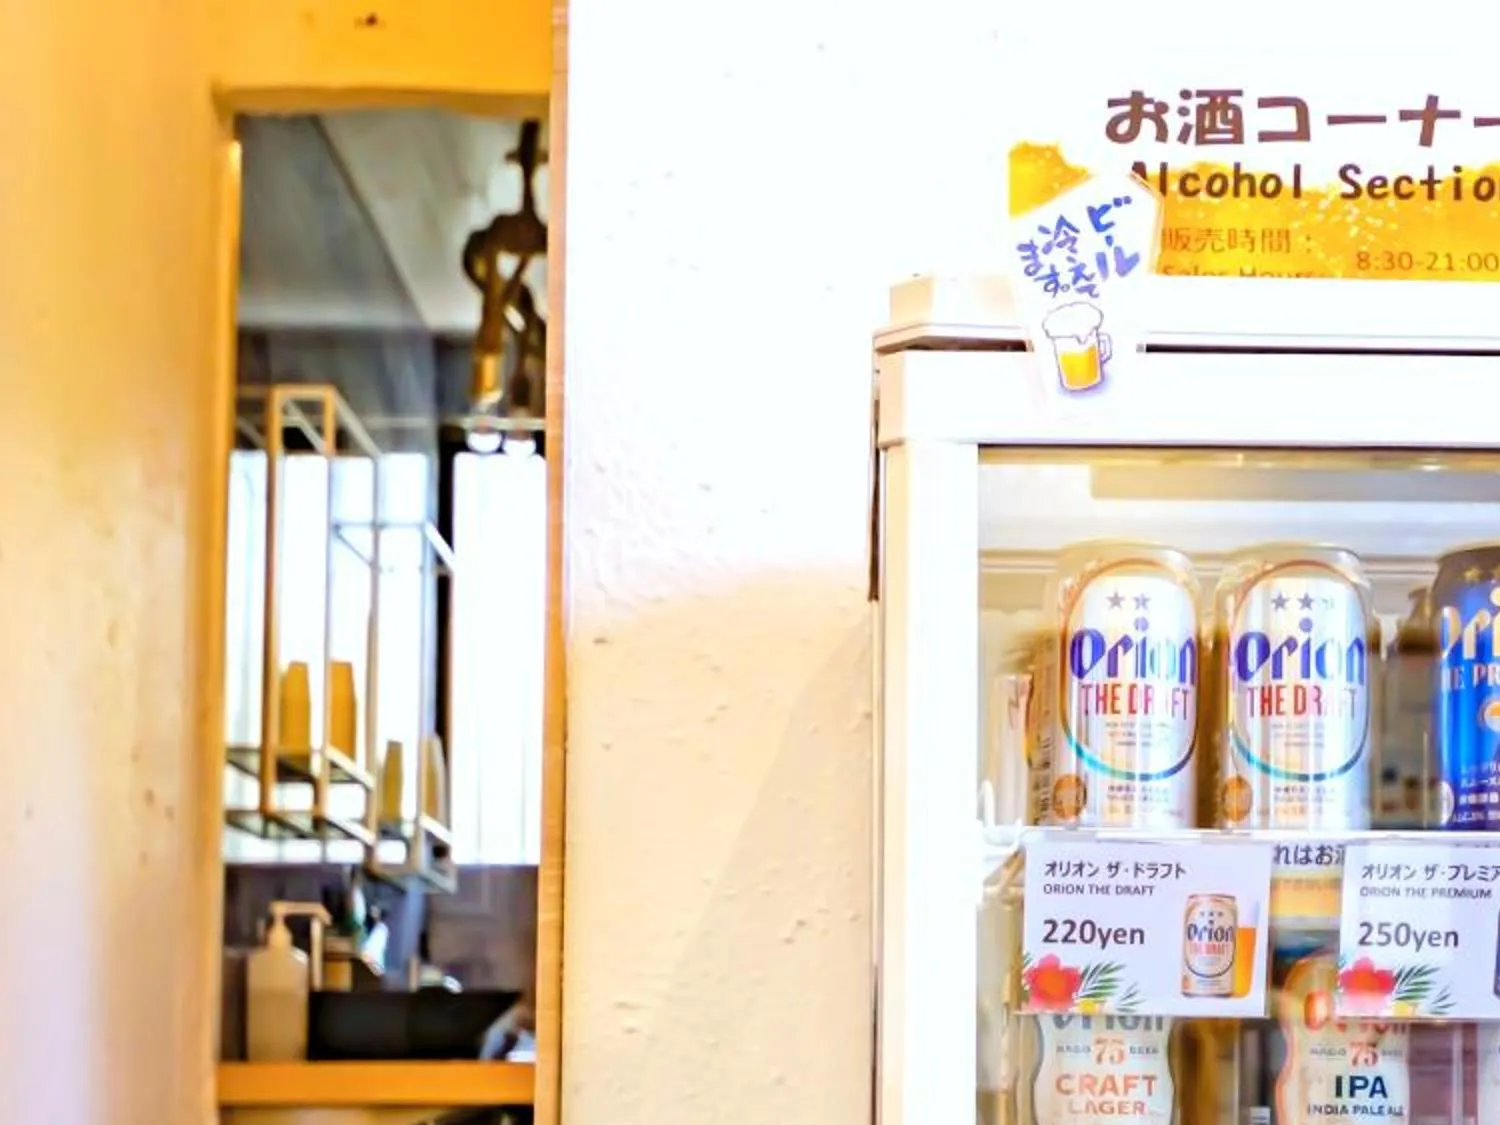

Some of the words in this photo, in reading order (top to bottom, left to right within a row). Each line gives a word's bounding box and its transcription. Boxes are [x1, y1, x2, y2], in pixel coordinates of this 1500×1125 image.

[1355, 251, 1500, 273] 8:30-21:00
[1081, 683, 1122, 716] THE
[1247, 684, 1286, 718] THE
[1044, 861, 1099, 878] オリオン
[1106, 861, 1187, 880] ザ・ドラフト
[1361, 864, 1417, 881] オリオン
[1042, 883, 1086, 896] ORION
[1088, 884, 1111, 896] THE
[1115, 884, 1156, 897] DRAFT
[1359, 887, 1401, 898] ORION
[1404, 887, 1430, 899] THE
[1431, 888, 1493, 900] PREMIUM
[1042, 918, 1146, 950] 220yen
[1357, 921, 1460, 952] 250yen
[1056, 1073, 1159, 1097] CRAFT
[1335, 1075, 1389, 1099] IPA
[1068, 1099, 1148, 1116] LAGER
[1307, 1103, 1350, 1116] INDIA
[1352, 1103, 1386, 1116] PALE
